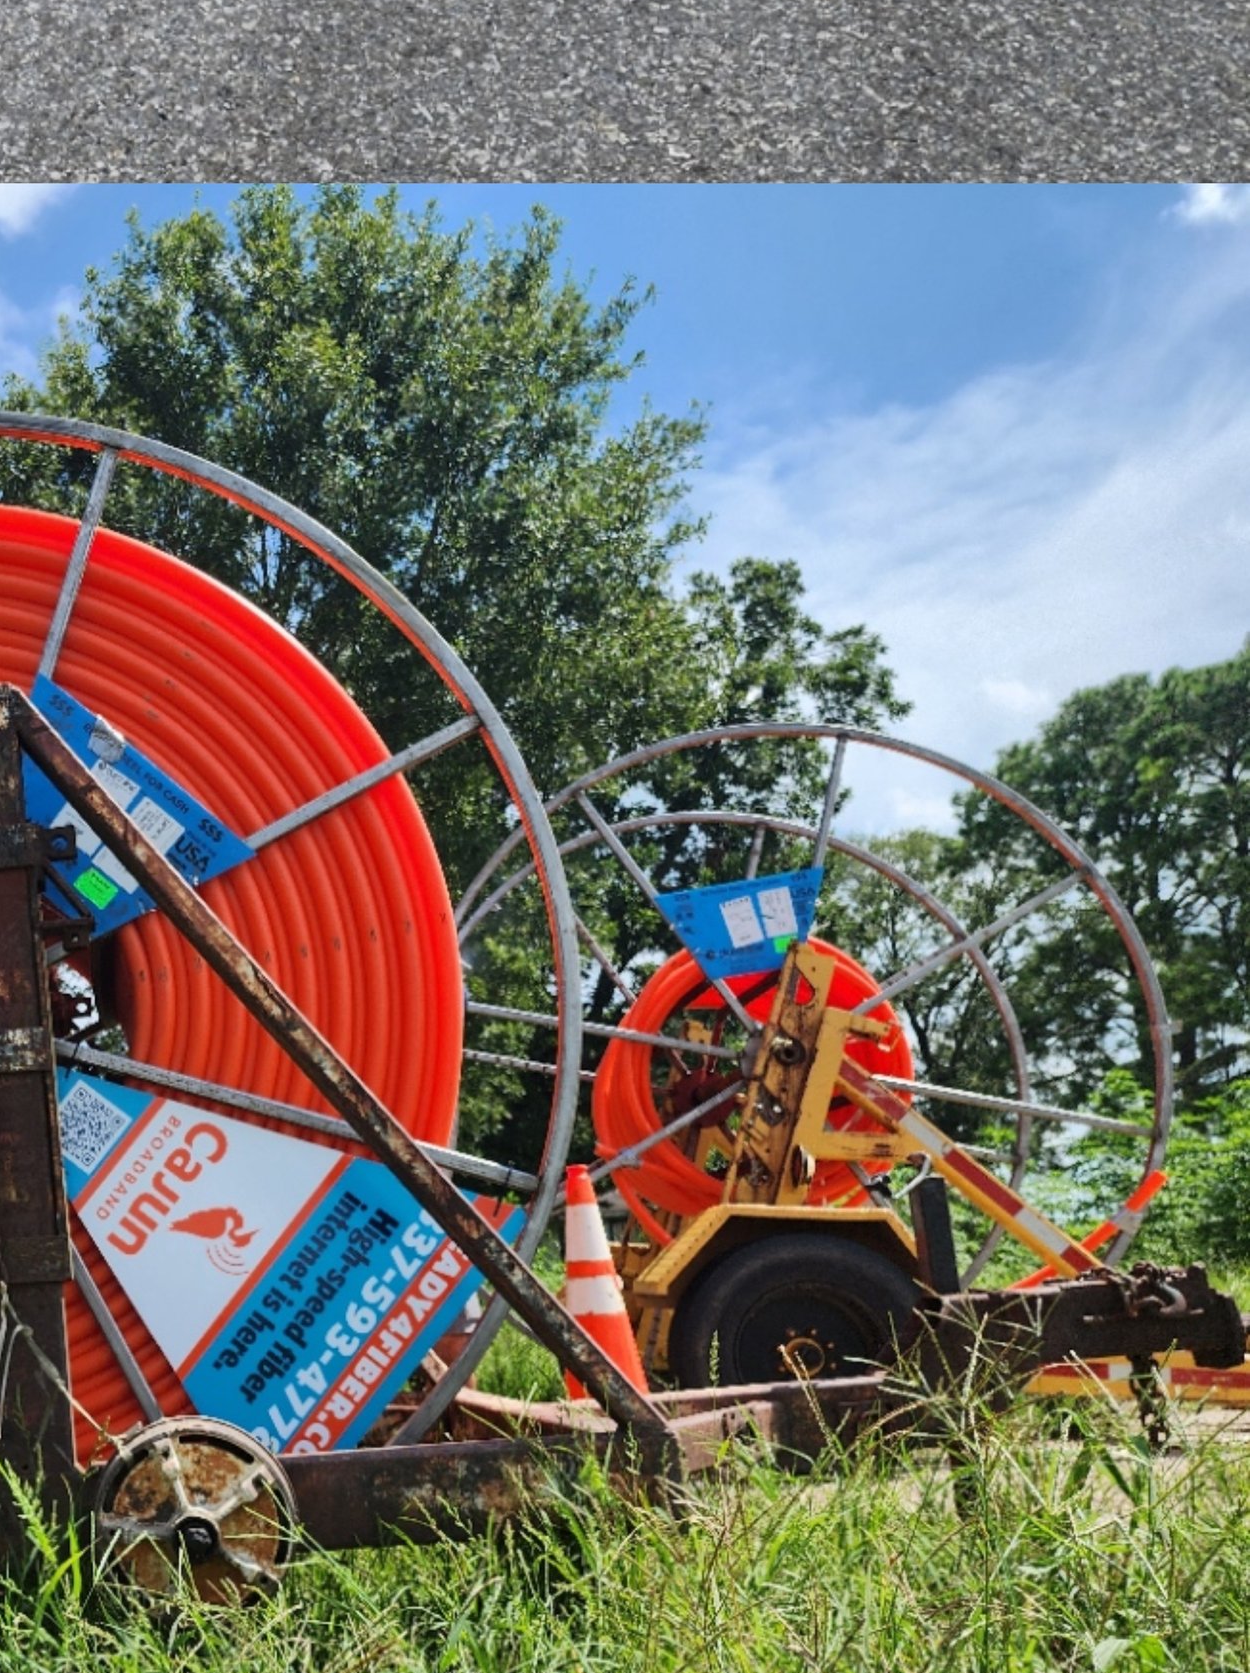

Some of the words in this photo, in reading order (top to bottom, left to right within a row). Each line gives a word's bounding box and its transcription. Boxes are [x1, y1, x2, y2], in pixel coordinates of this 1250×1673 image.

[174, 835, 210, 873] USA
[96, 1115, 181, 1220] BROADBAND
[279, 1191, 367, 1292] internet
[263, 1286, 293, 1313] is
[282, 1208, 400, 1349] High-speed
[213, 1311, 275, 1371] here.
[239, 1343, 296, 1405] fiber
